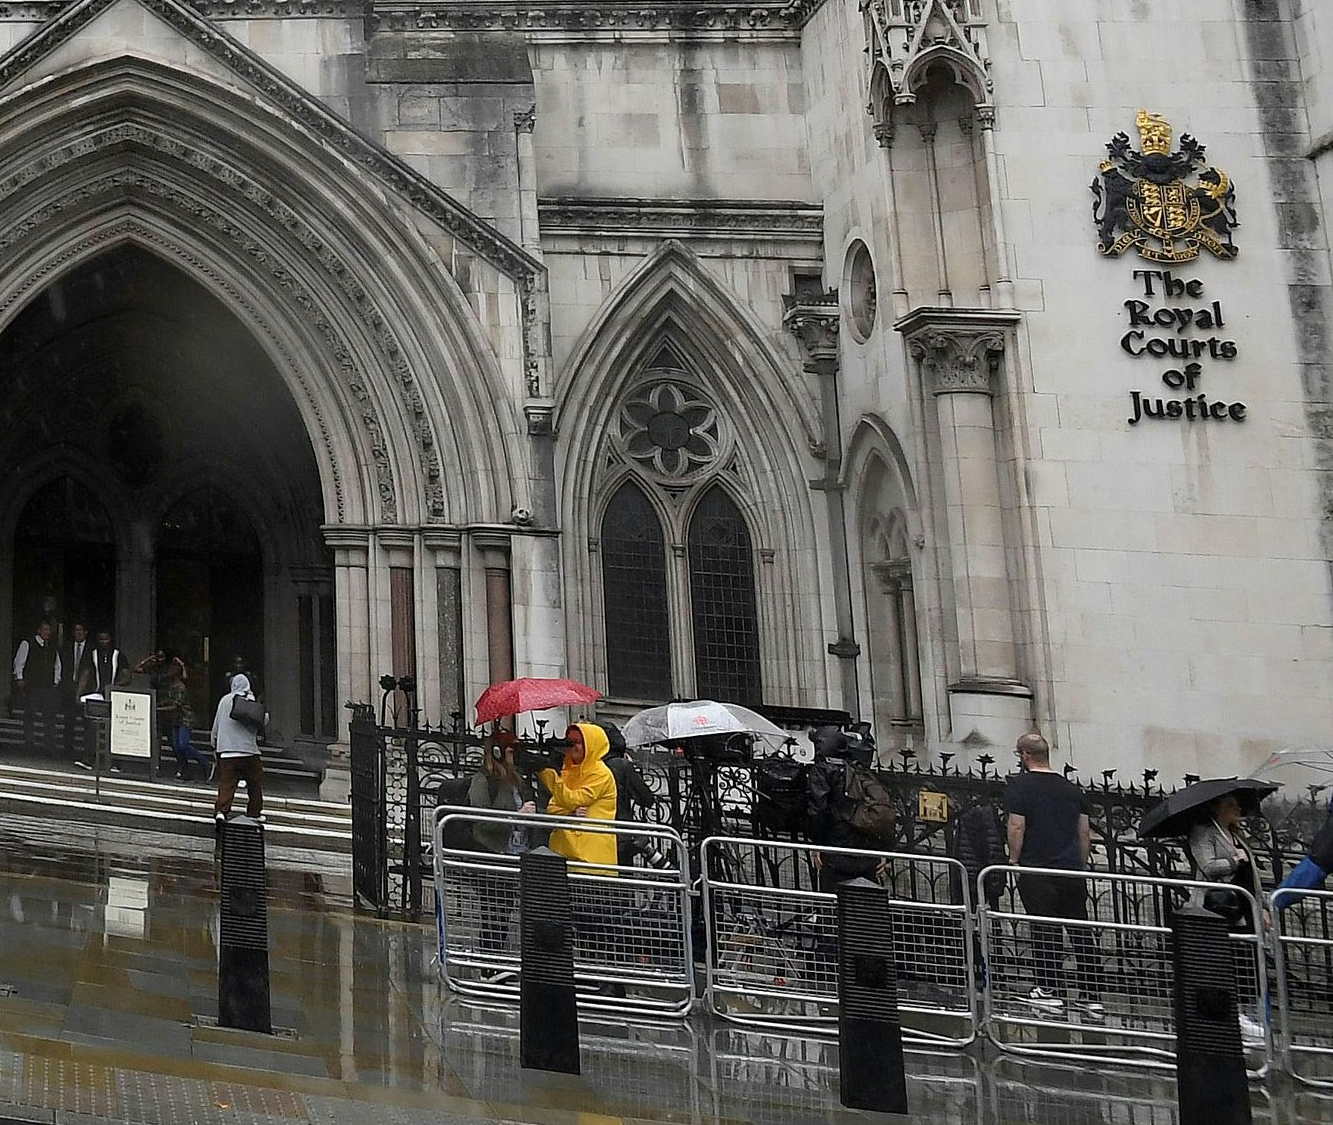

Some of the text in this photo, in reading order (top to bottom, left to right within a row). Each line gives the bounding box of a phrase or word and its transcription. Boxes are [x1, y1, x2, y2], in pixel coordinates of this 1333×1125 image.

[1132, 269, 1205, 297] The
[1124, 299, 1226, 334] Royal
[1121, 329, 1238, 359] Courts
[1162, 362, 1203, 390] of
[1127, 390, 1248, 425] Justice
